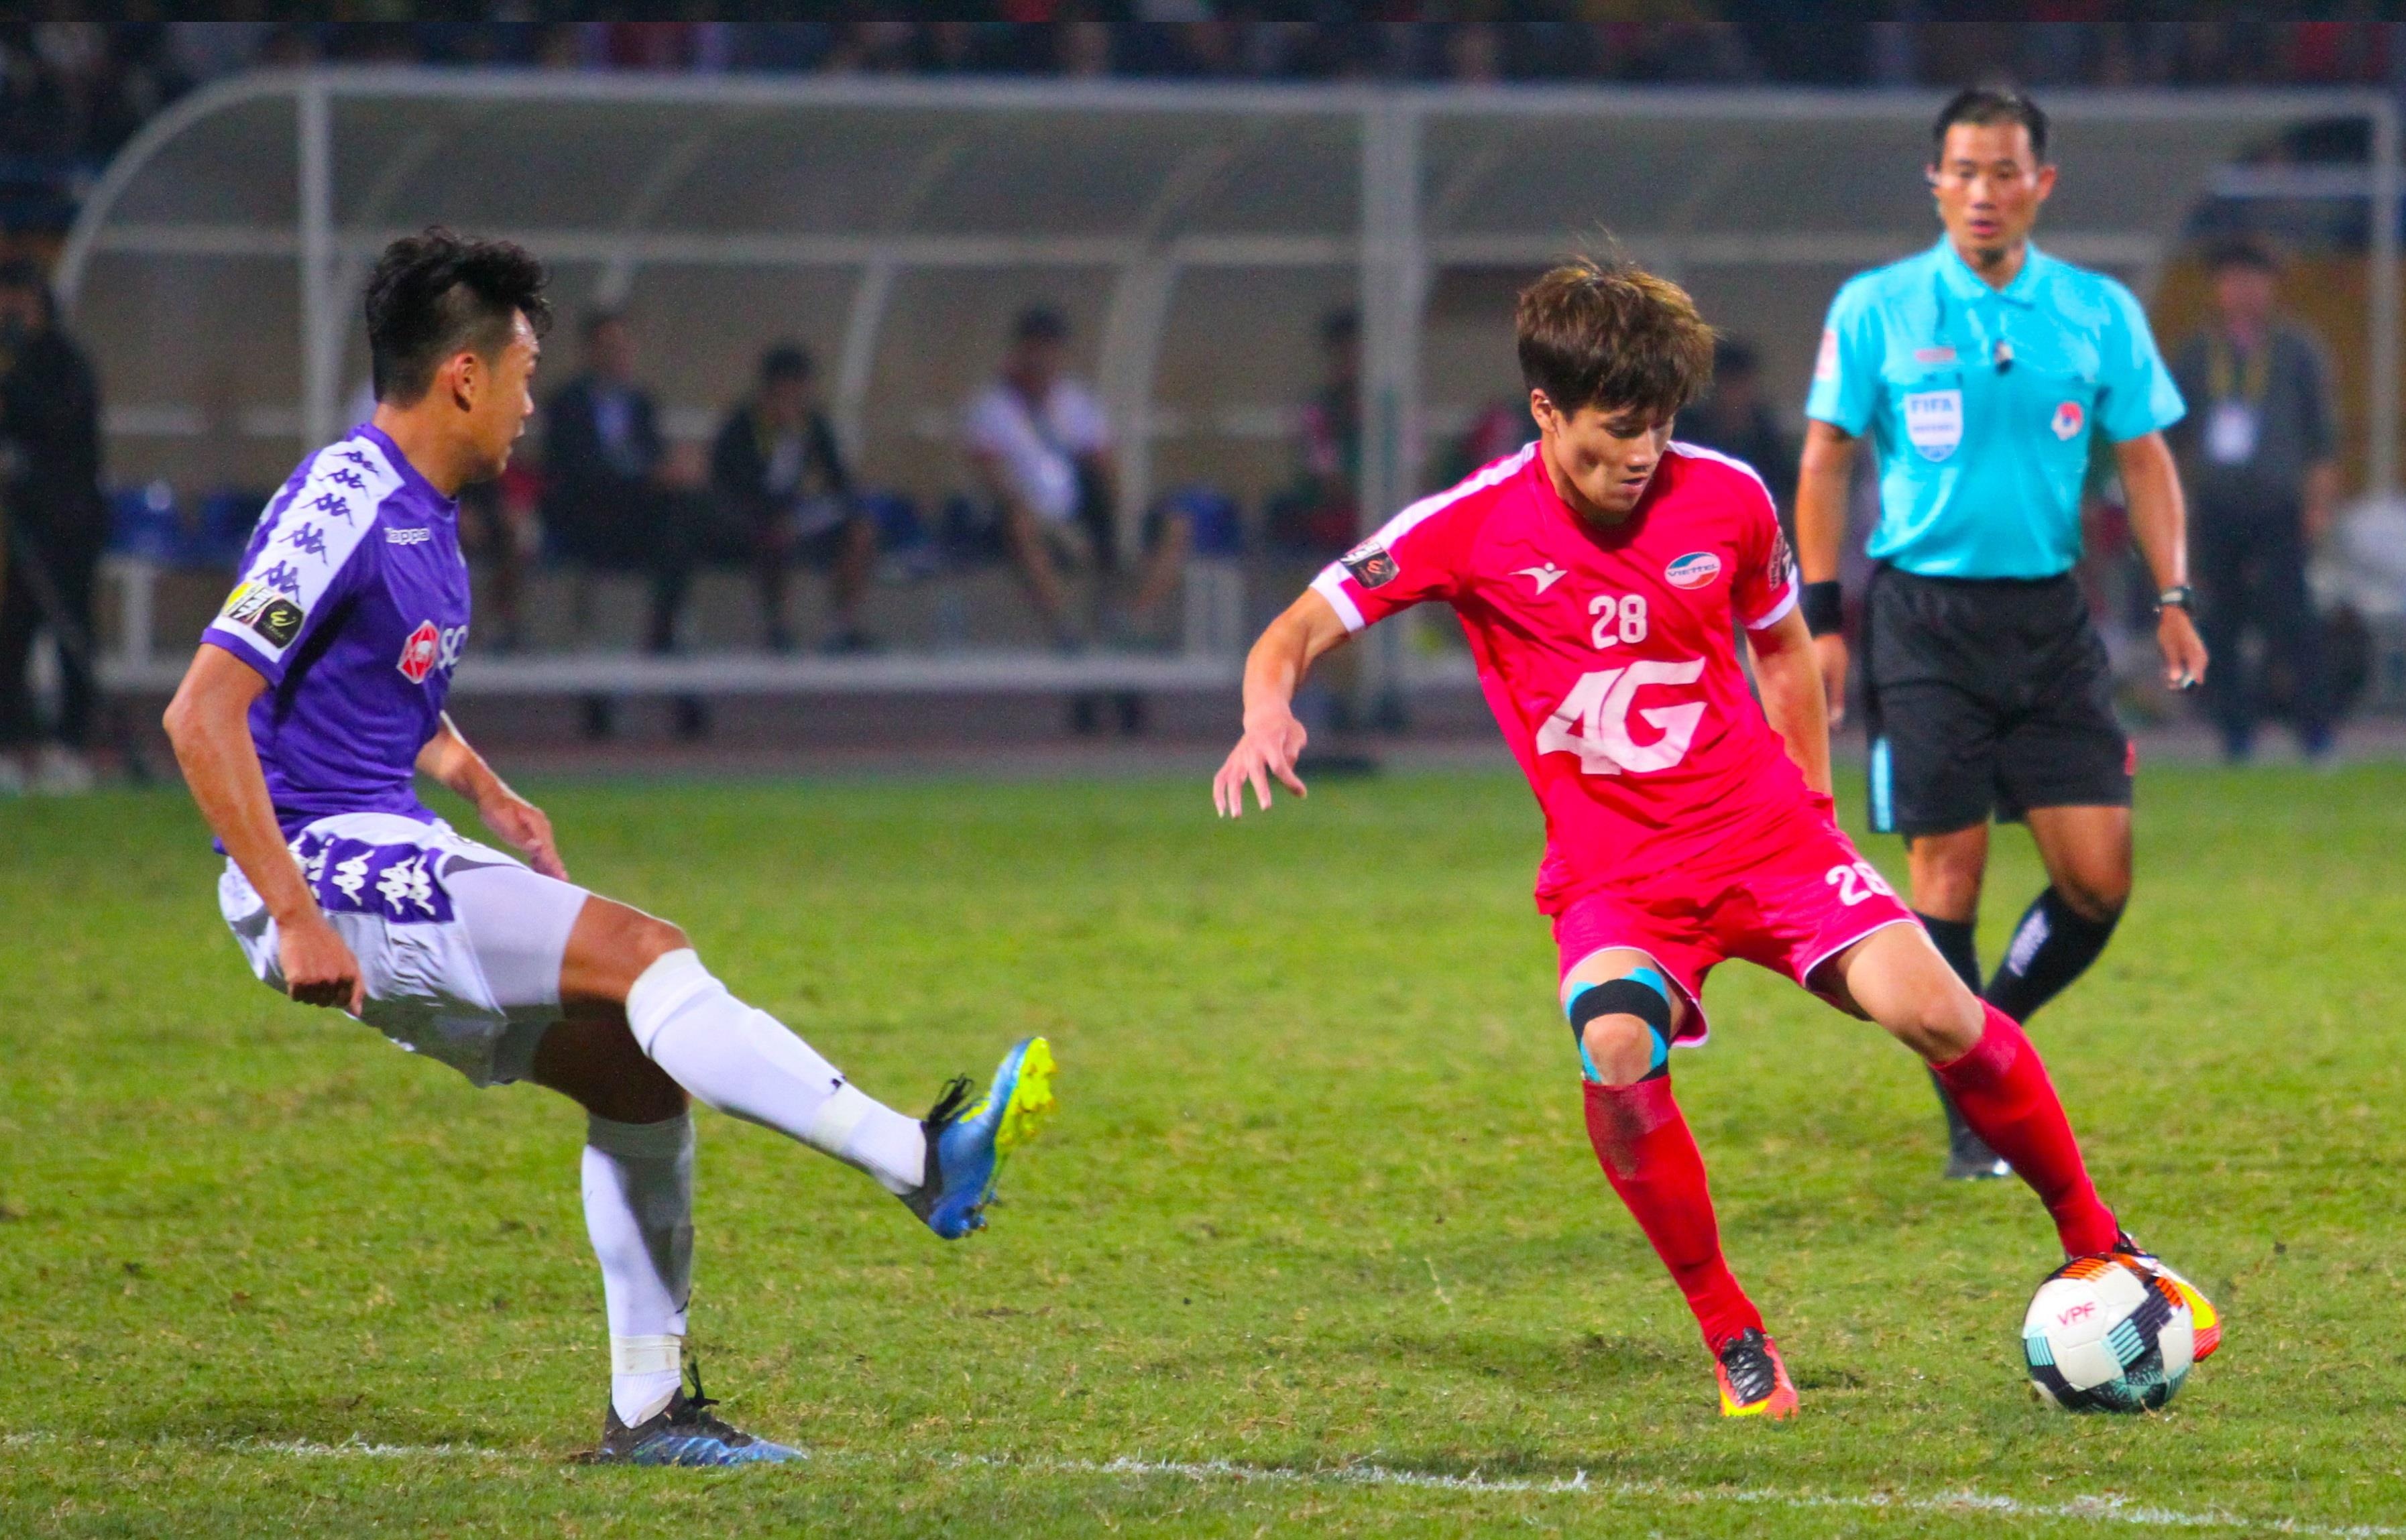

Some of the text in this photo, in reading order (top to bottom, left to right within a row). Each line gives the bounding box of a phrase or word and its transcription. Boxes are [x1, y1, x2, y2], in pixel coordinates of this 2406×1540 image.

[1911, 398, 1954, 413] FIFA
[1667, 564, 1717, 577] VIETTEL
[1588, 594, 1647, 650] 28
[1536, 656, 1707, 776] 4G
[1825, 862, 1894, 906] 28
[2057, 1301, 2096, 1325] VPF
